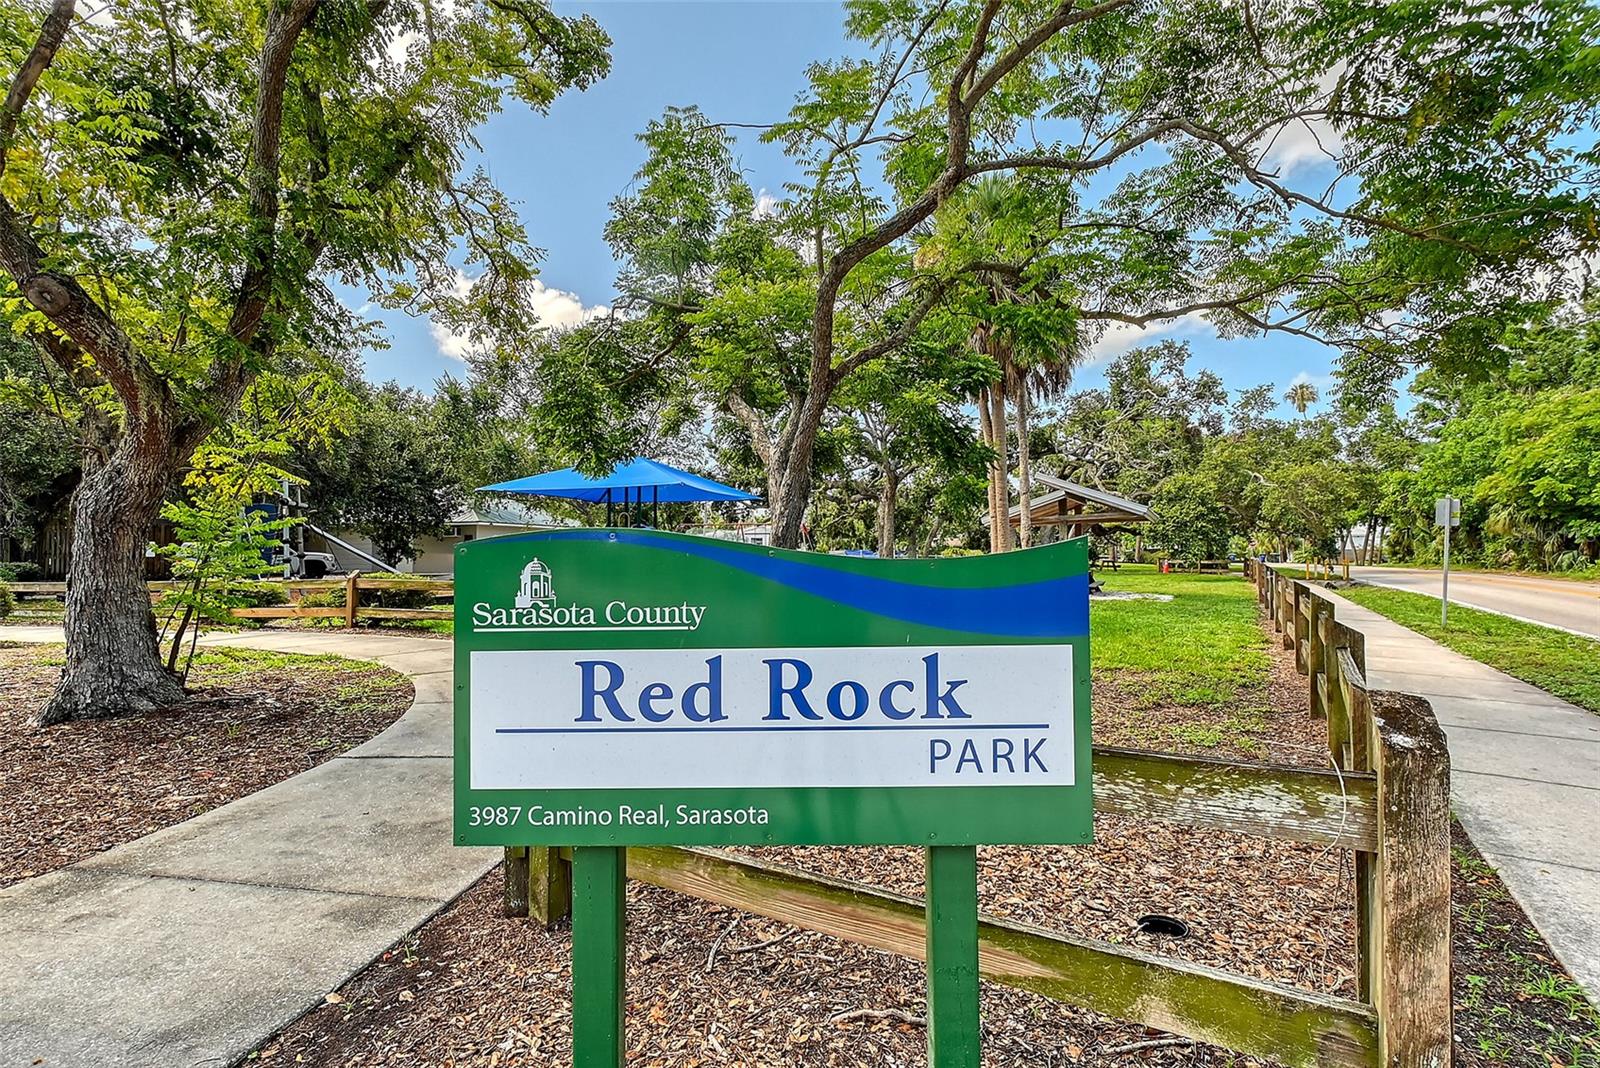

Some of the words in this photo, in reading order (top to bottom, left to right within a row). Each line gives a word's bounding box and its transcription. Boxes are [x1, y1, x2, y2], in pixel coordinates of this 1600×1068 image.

[472, 602, 597, 626] Sarasota
[605, 601, 707, 630] County
[574, 654, 729, 723] Red
[762, 652, 973, 721] Rock
[929, 737, 1049, 774] PARK
[469, 806, 522, 826] 3987
[527, 805, 612, 826] Camino
[619, 804, 670, 828] Real,
[676, 804, 769, 825] Sarasota
